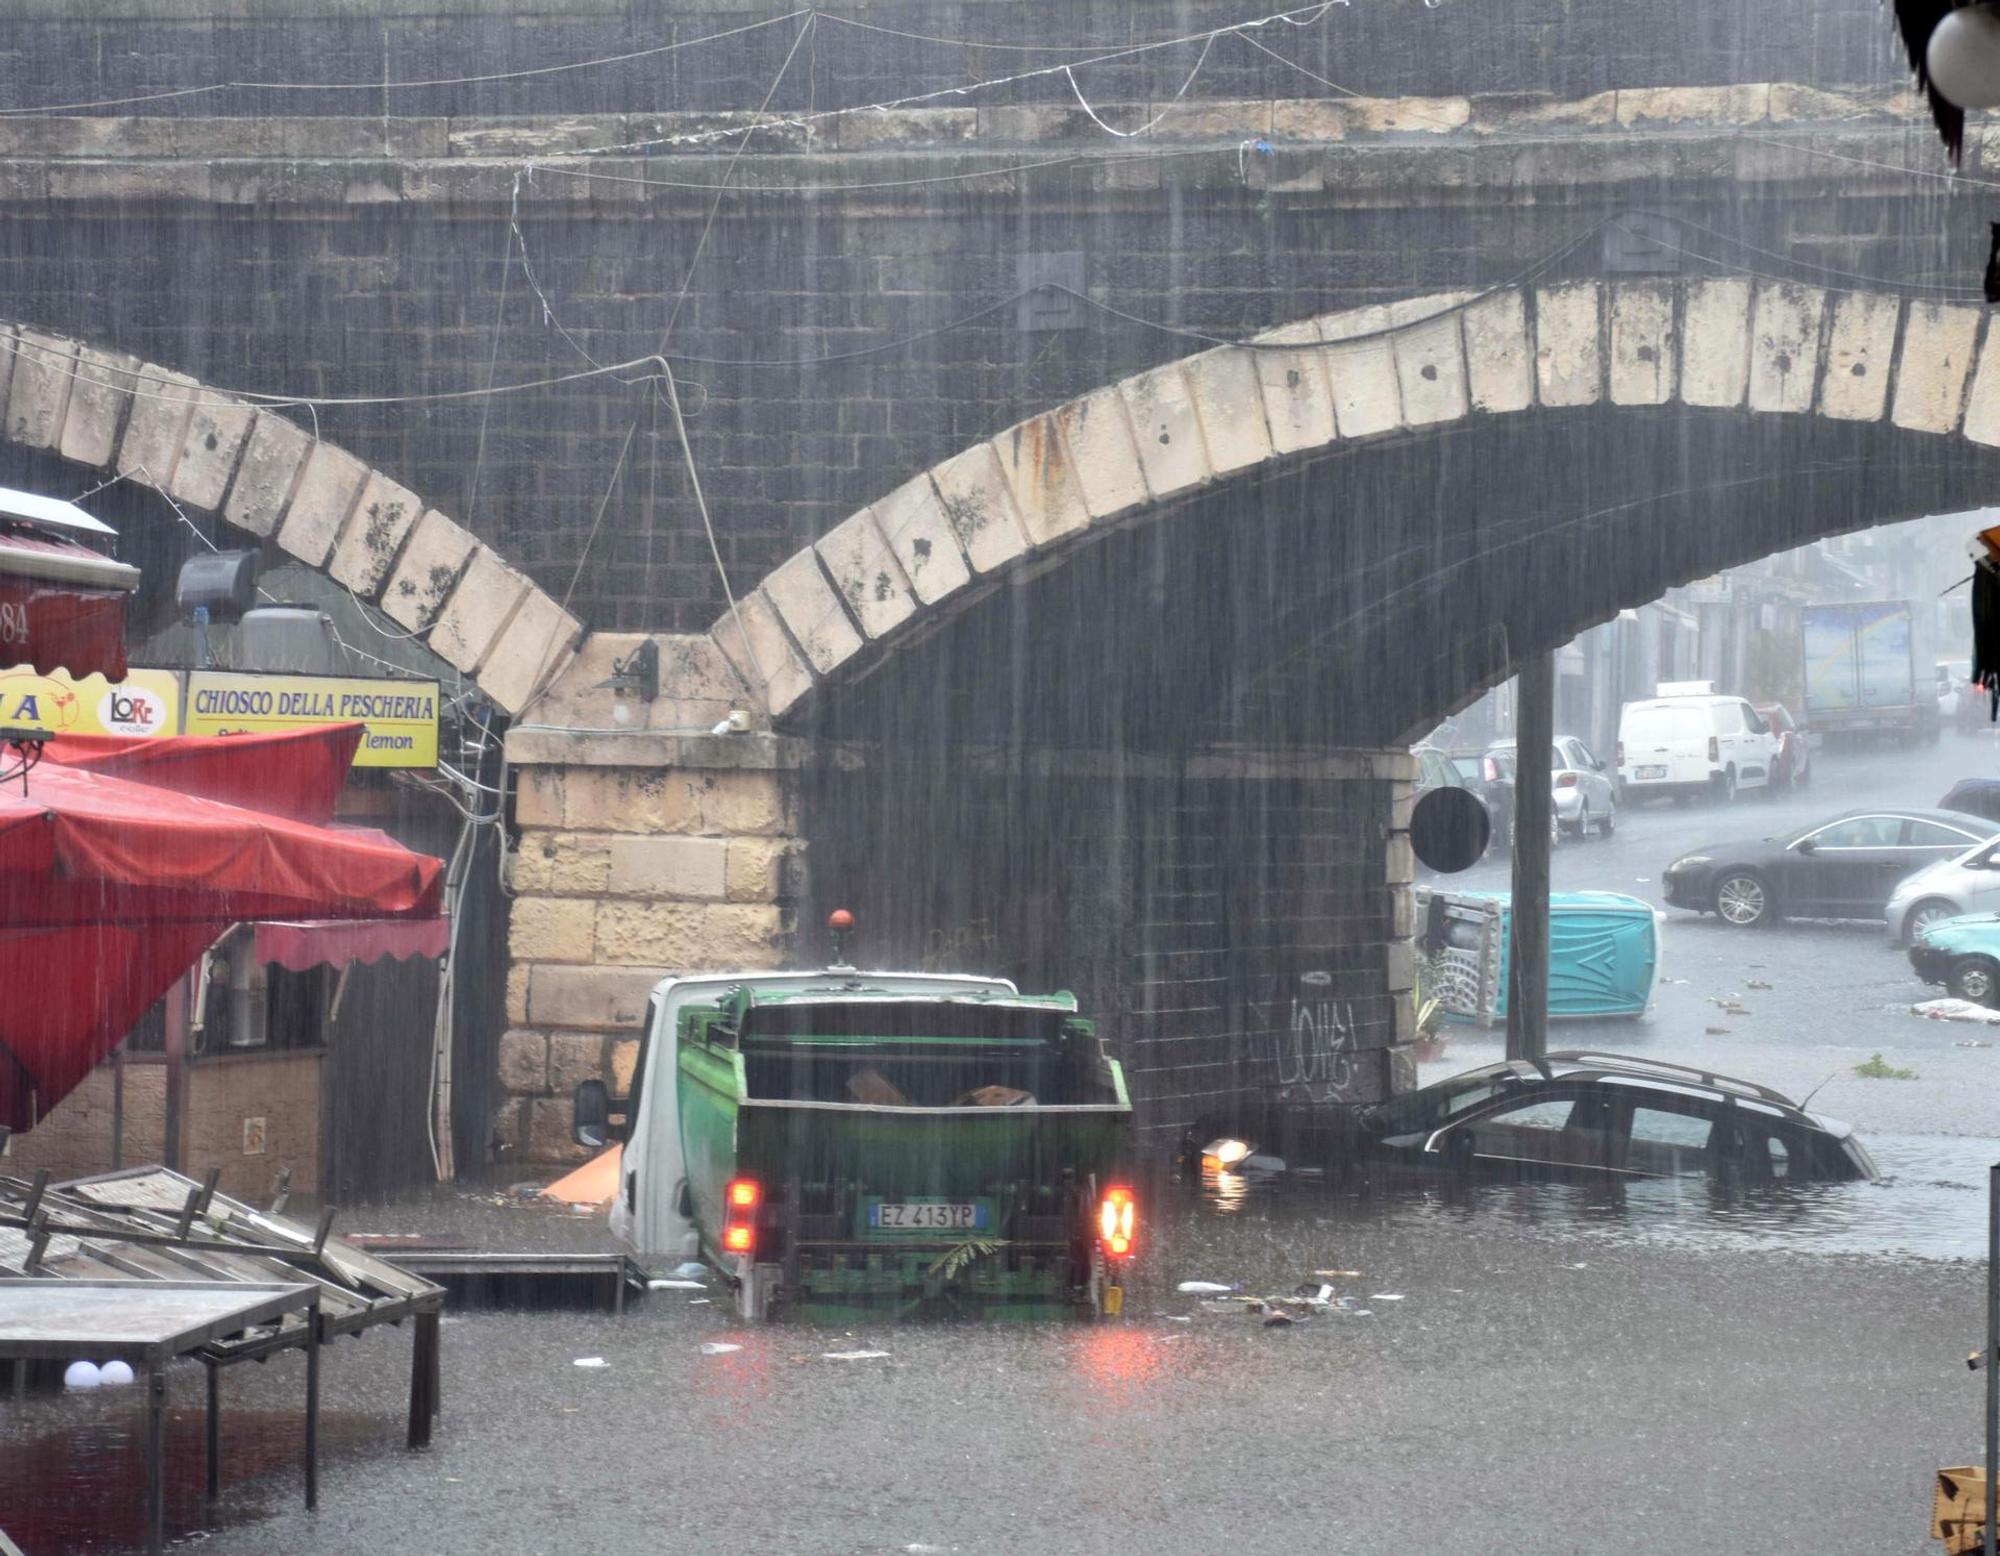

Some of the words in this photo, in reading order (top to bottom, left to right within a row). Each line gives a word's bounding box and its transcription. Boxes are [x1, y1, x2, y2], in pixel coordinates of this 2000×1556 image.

[0, 601, 29, 644] 84
[0, 693, 41, 721] A
[195, 689, 273, 715] CHIOSCO
[277, 692, 334, 716] DELLA
[340, 694, 433, 719] PESCHERIA
[881, 1206, 904, 1226] EZ
